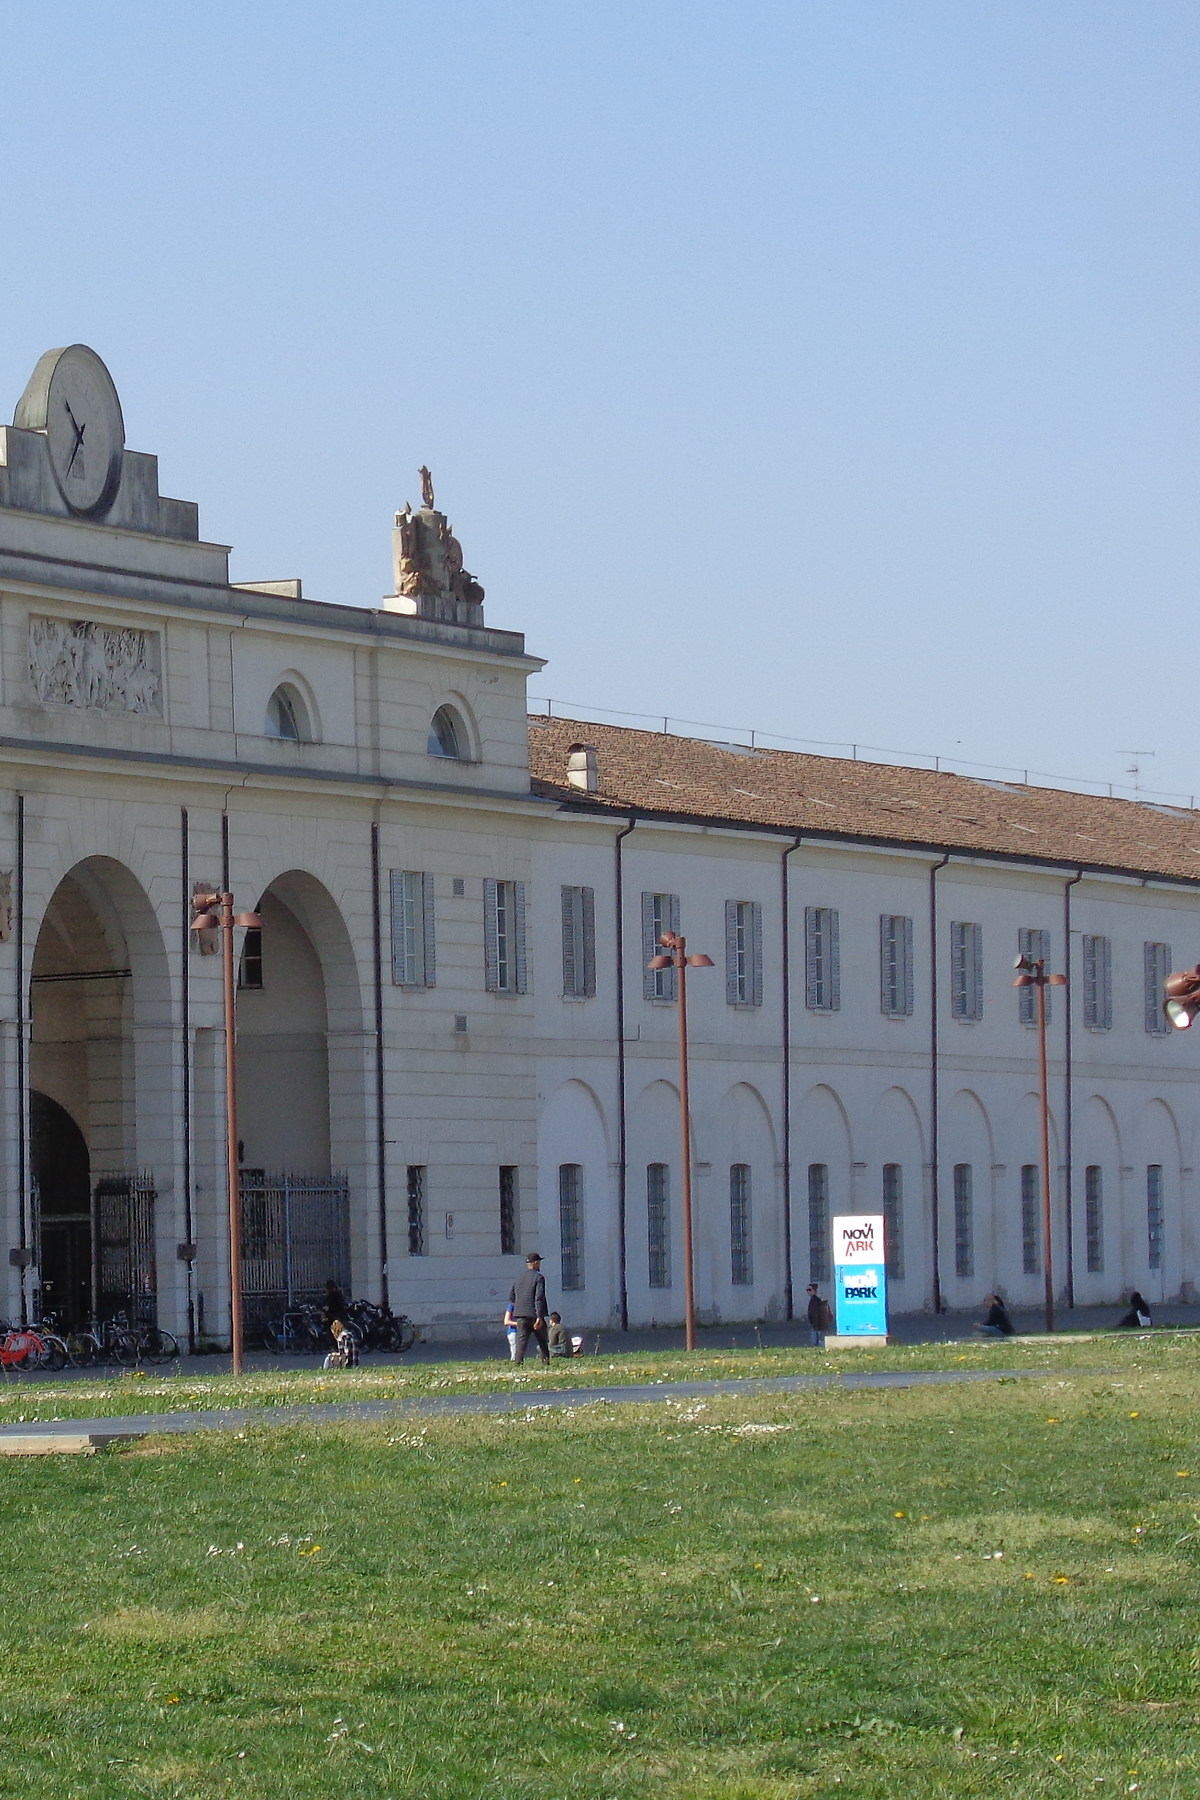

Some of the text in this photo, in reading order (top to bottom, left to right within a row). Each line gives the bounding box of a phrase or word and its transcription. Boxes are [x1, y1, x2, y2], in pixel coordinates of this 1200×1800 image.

[843, 1223, 874, 1239] NOVI
[845, 1241, 874, 1256] ARK
[845, 1287, 877, 1298] PARK
